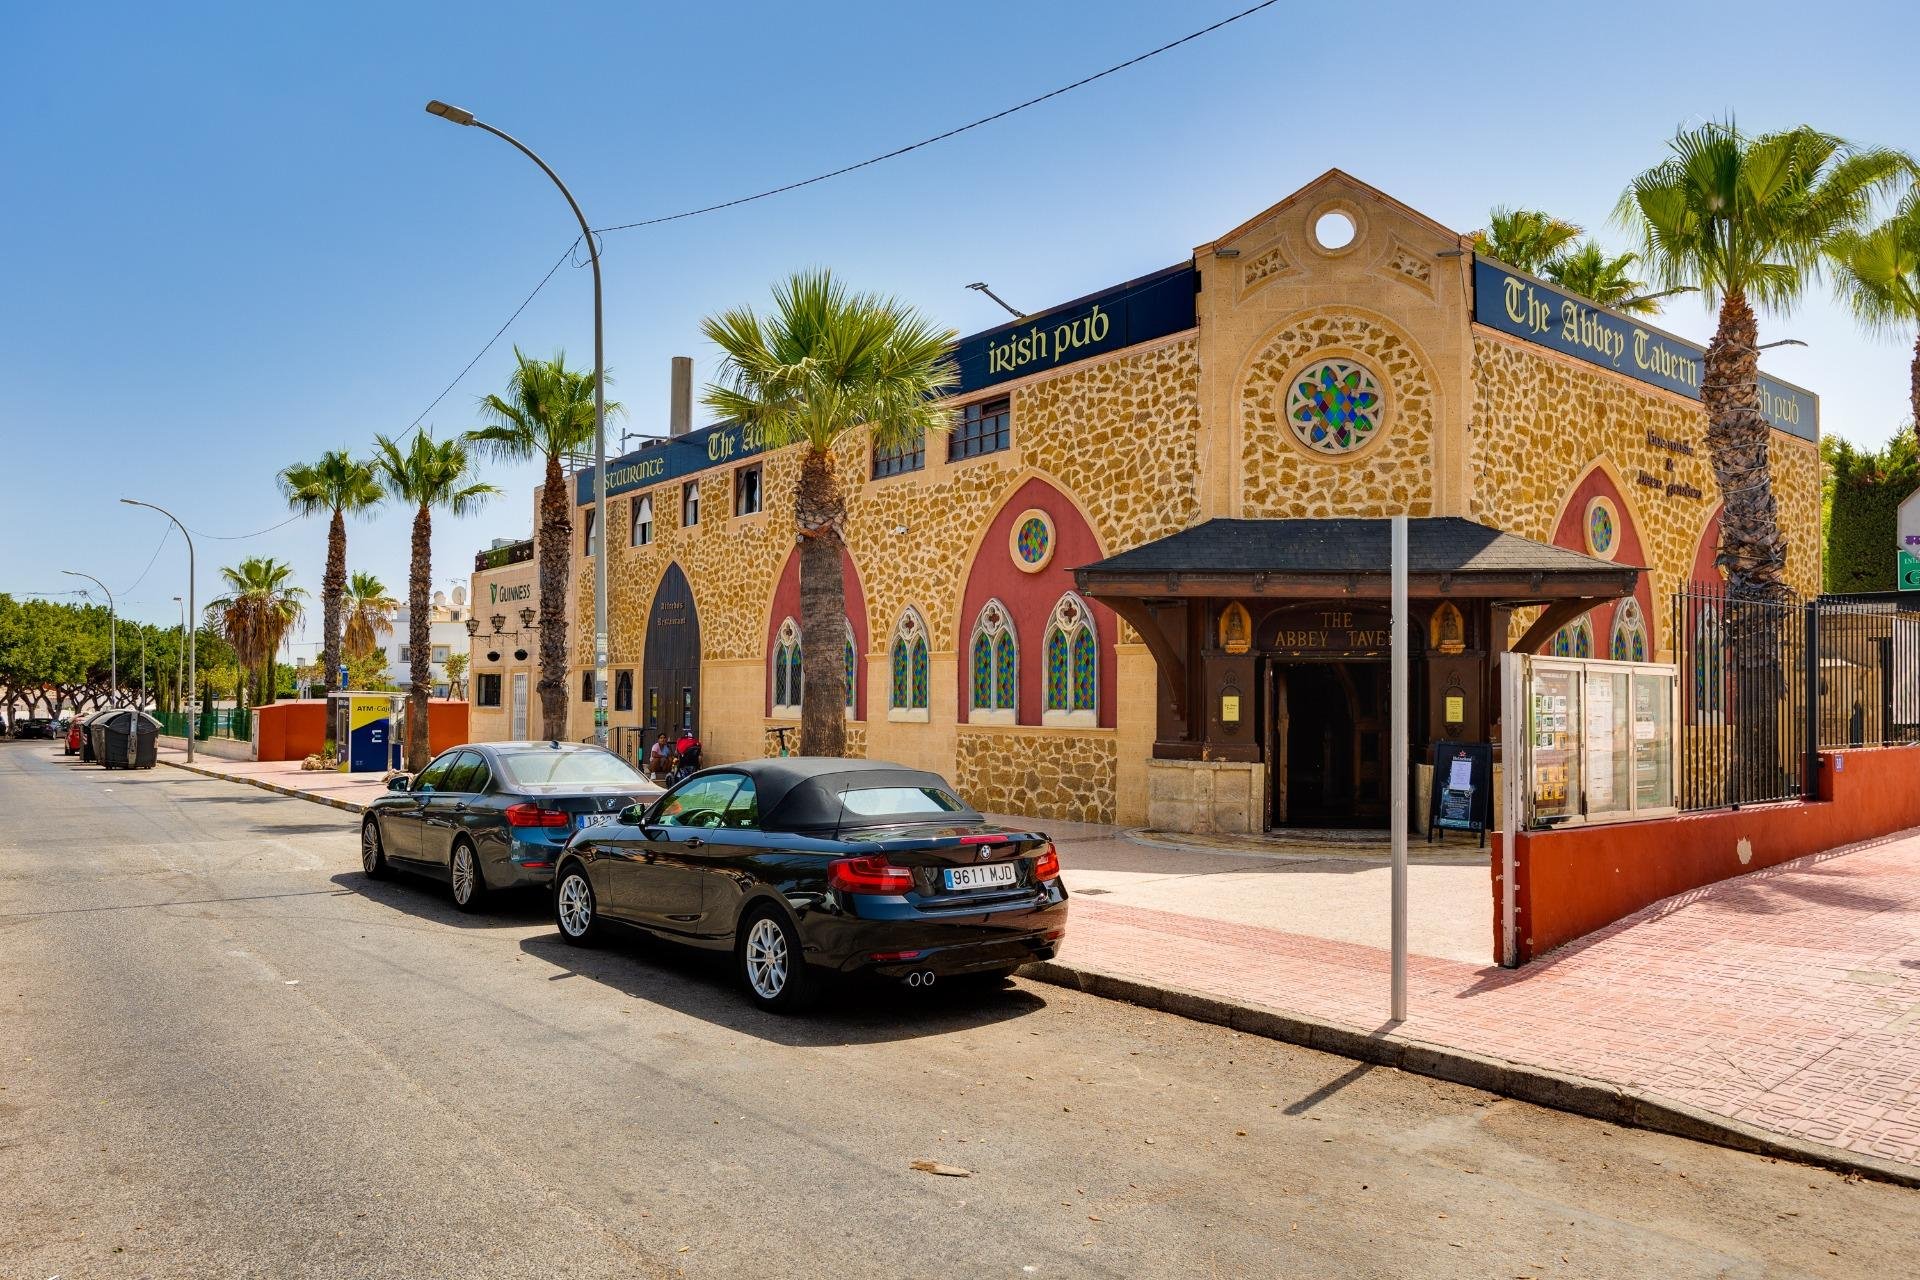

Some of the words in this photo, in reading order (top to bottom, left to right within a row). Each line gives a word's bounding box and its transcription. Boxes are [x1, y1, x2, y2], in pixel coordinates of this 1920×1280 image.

[1054, 305, 1110, 362] pub
[1504, 276, 1550, 334] The
[1561, 300, 1625, 367] Abbey
[1633, 328, 1697, 387] Tavern
[1774, 395, 1799, 425] pub
[708, 430, 736, 463] The
[500, 584, 531, 603] GUINNESS
[1320, 612, 1353, 628] THE
[1275, 631, 1329, 647] ABBEY
[1346, 630, 1392, 647] TAVE
[953, 868, 985, 885] 9611
[989, 865, 1012, 881] MJD
